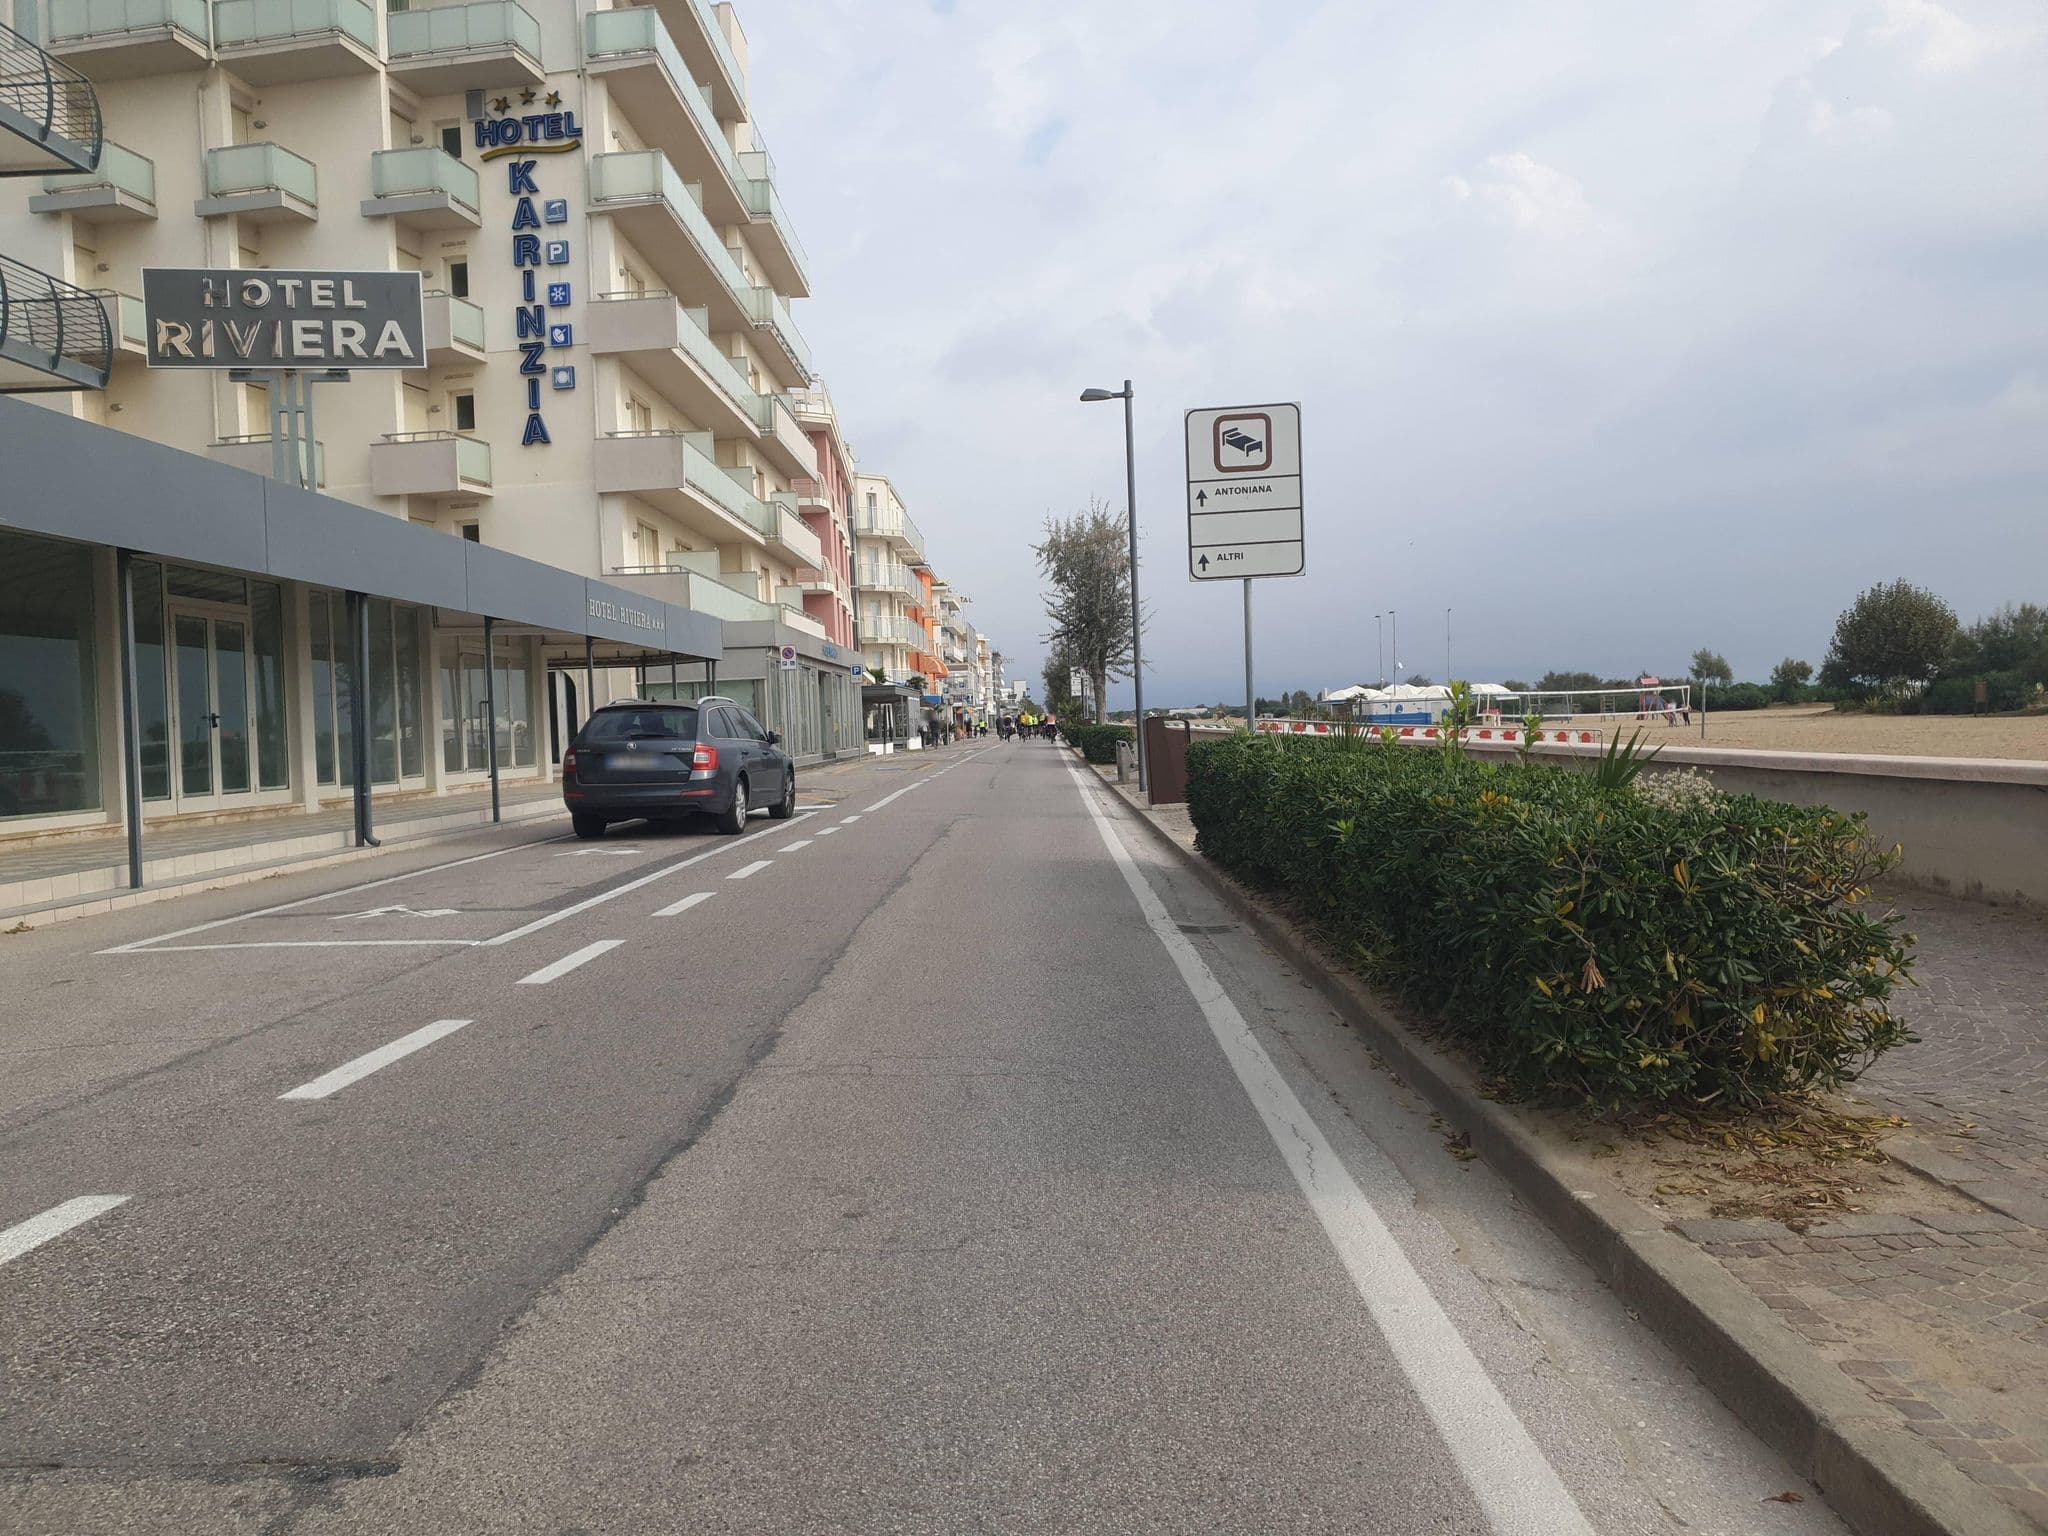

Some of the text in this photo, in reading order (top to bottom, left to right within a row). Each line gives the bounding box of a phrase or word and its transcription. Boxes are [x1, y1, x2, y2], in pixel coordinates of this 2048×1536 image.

[475, 111, 583, 147] HOTEL
[202, 278, 367, 309] HOTEL
[508, 160, 552, 445] KARINZIA
[156, 318, 415, 359] RIVIERA
[1215, 485, 1272, 496] ANTONIANA
[1217, 552, 1244, 561] ALTRI
[589, 598, 651, 629] HOTEL RIVIERA
